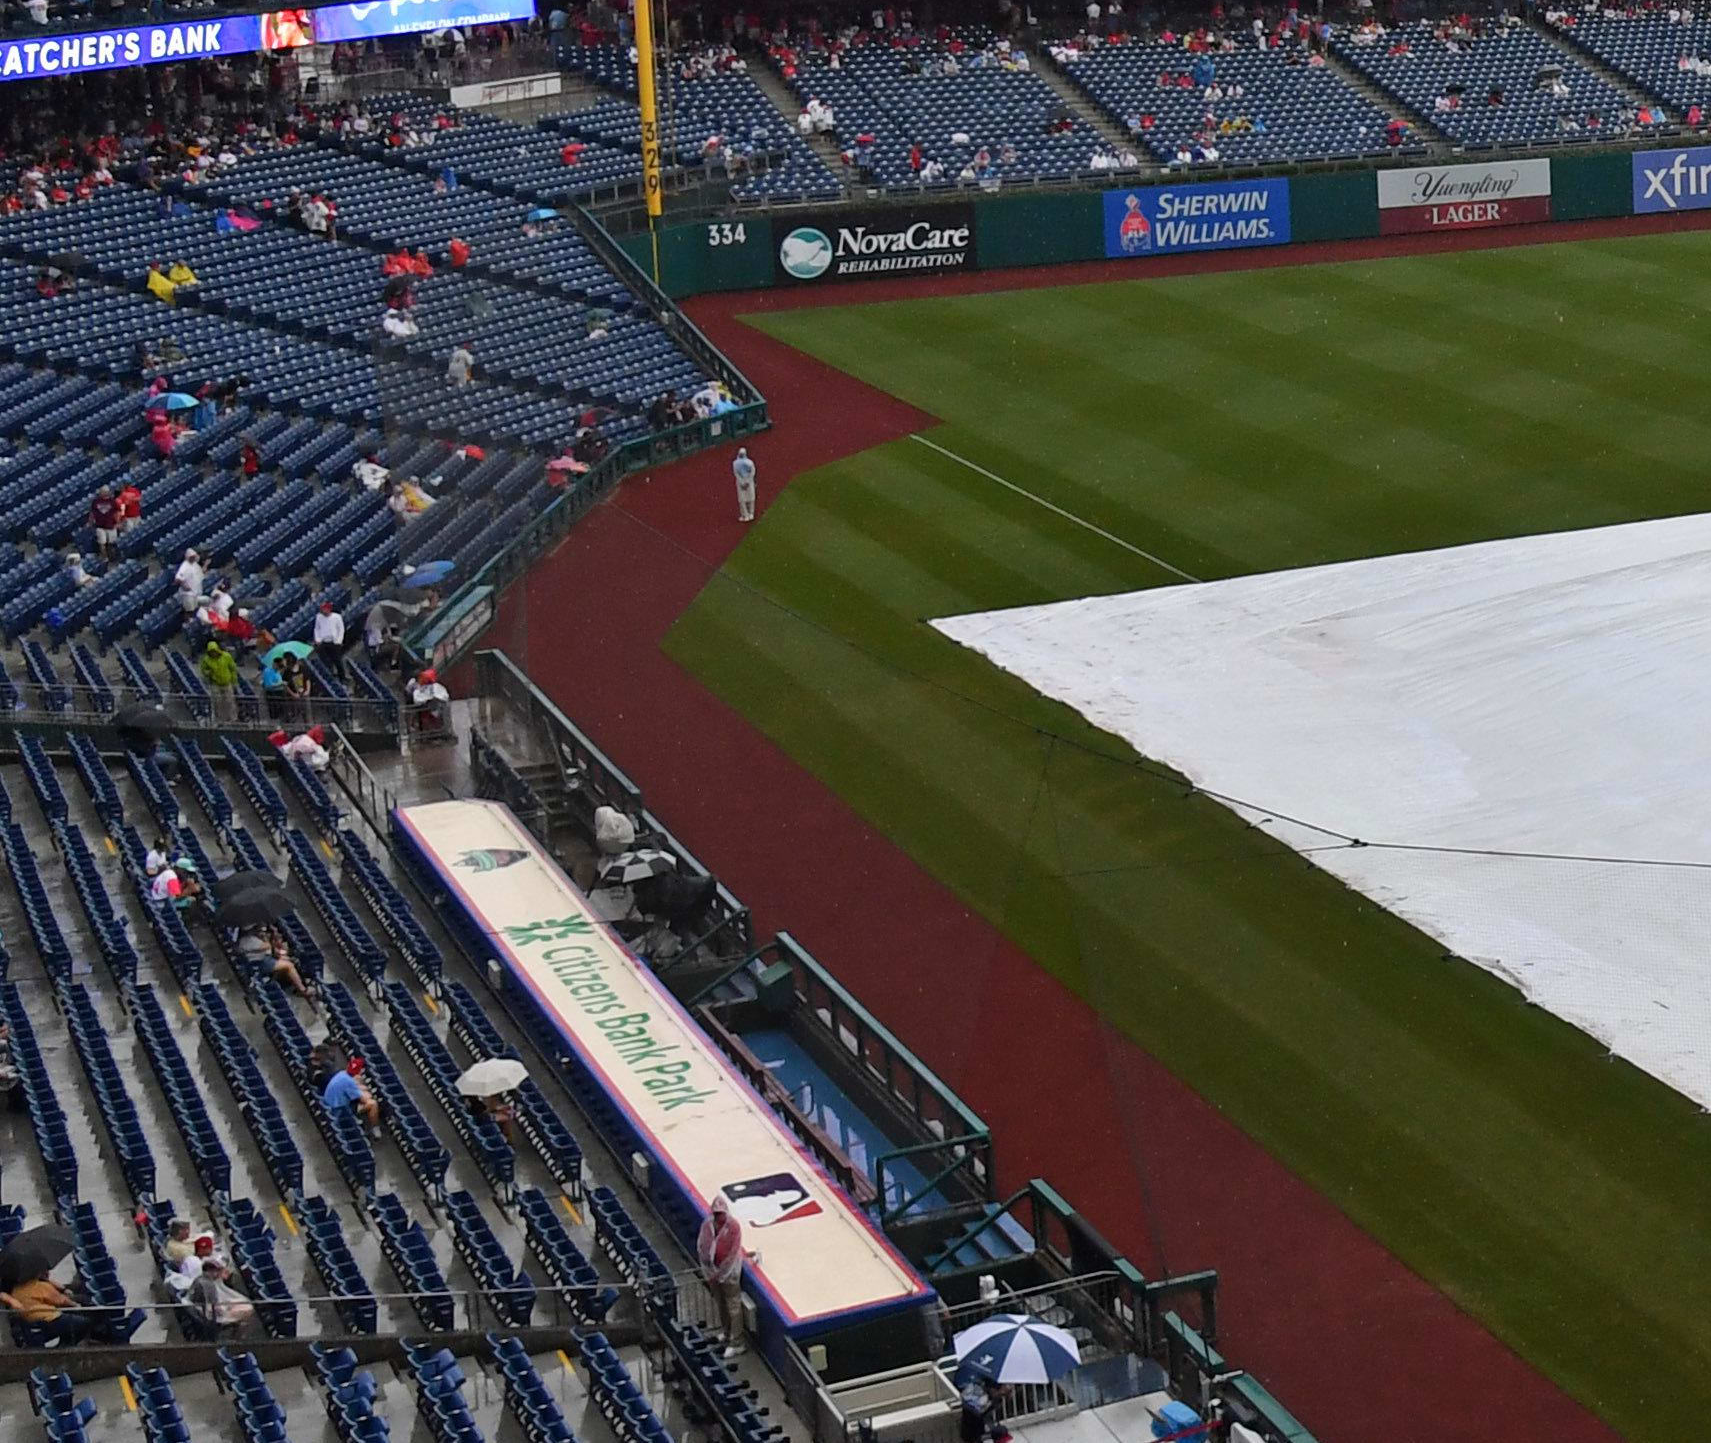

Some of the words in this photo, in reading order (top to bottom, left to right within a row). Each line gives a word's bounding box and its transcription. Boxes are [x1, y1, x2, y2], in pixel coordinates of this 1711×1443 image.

[150, 23, 223, 59] BANK
[645, 120, 659, 196] 329
[1156, 190, 1268, 219] SHERWIN
[1411, 169, 1520, 205] Yuengling
[1431, 202, 1501, 225] LAGER
[708, 223, 746, 247] 334
[835, 221, 970, 259] NovaCare
[838, 251, 965, 275] REHABILITATION
[542, 945, 614, 1030] Citizens
[596, 1013, 668, 1077] Bank
[634, 1054, 717, 1112] Park
